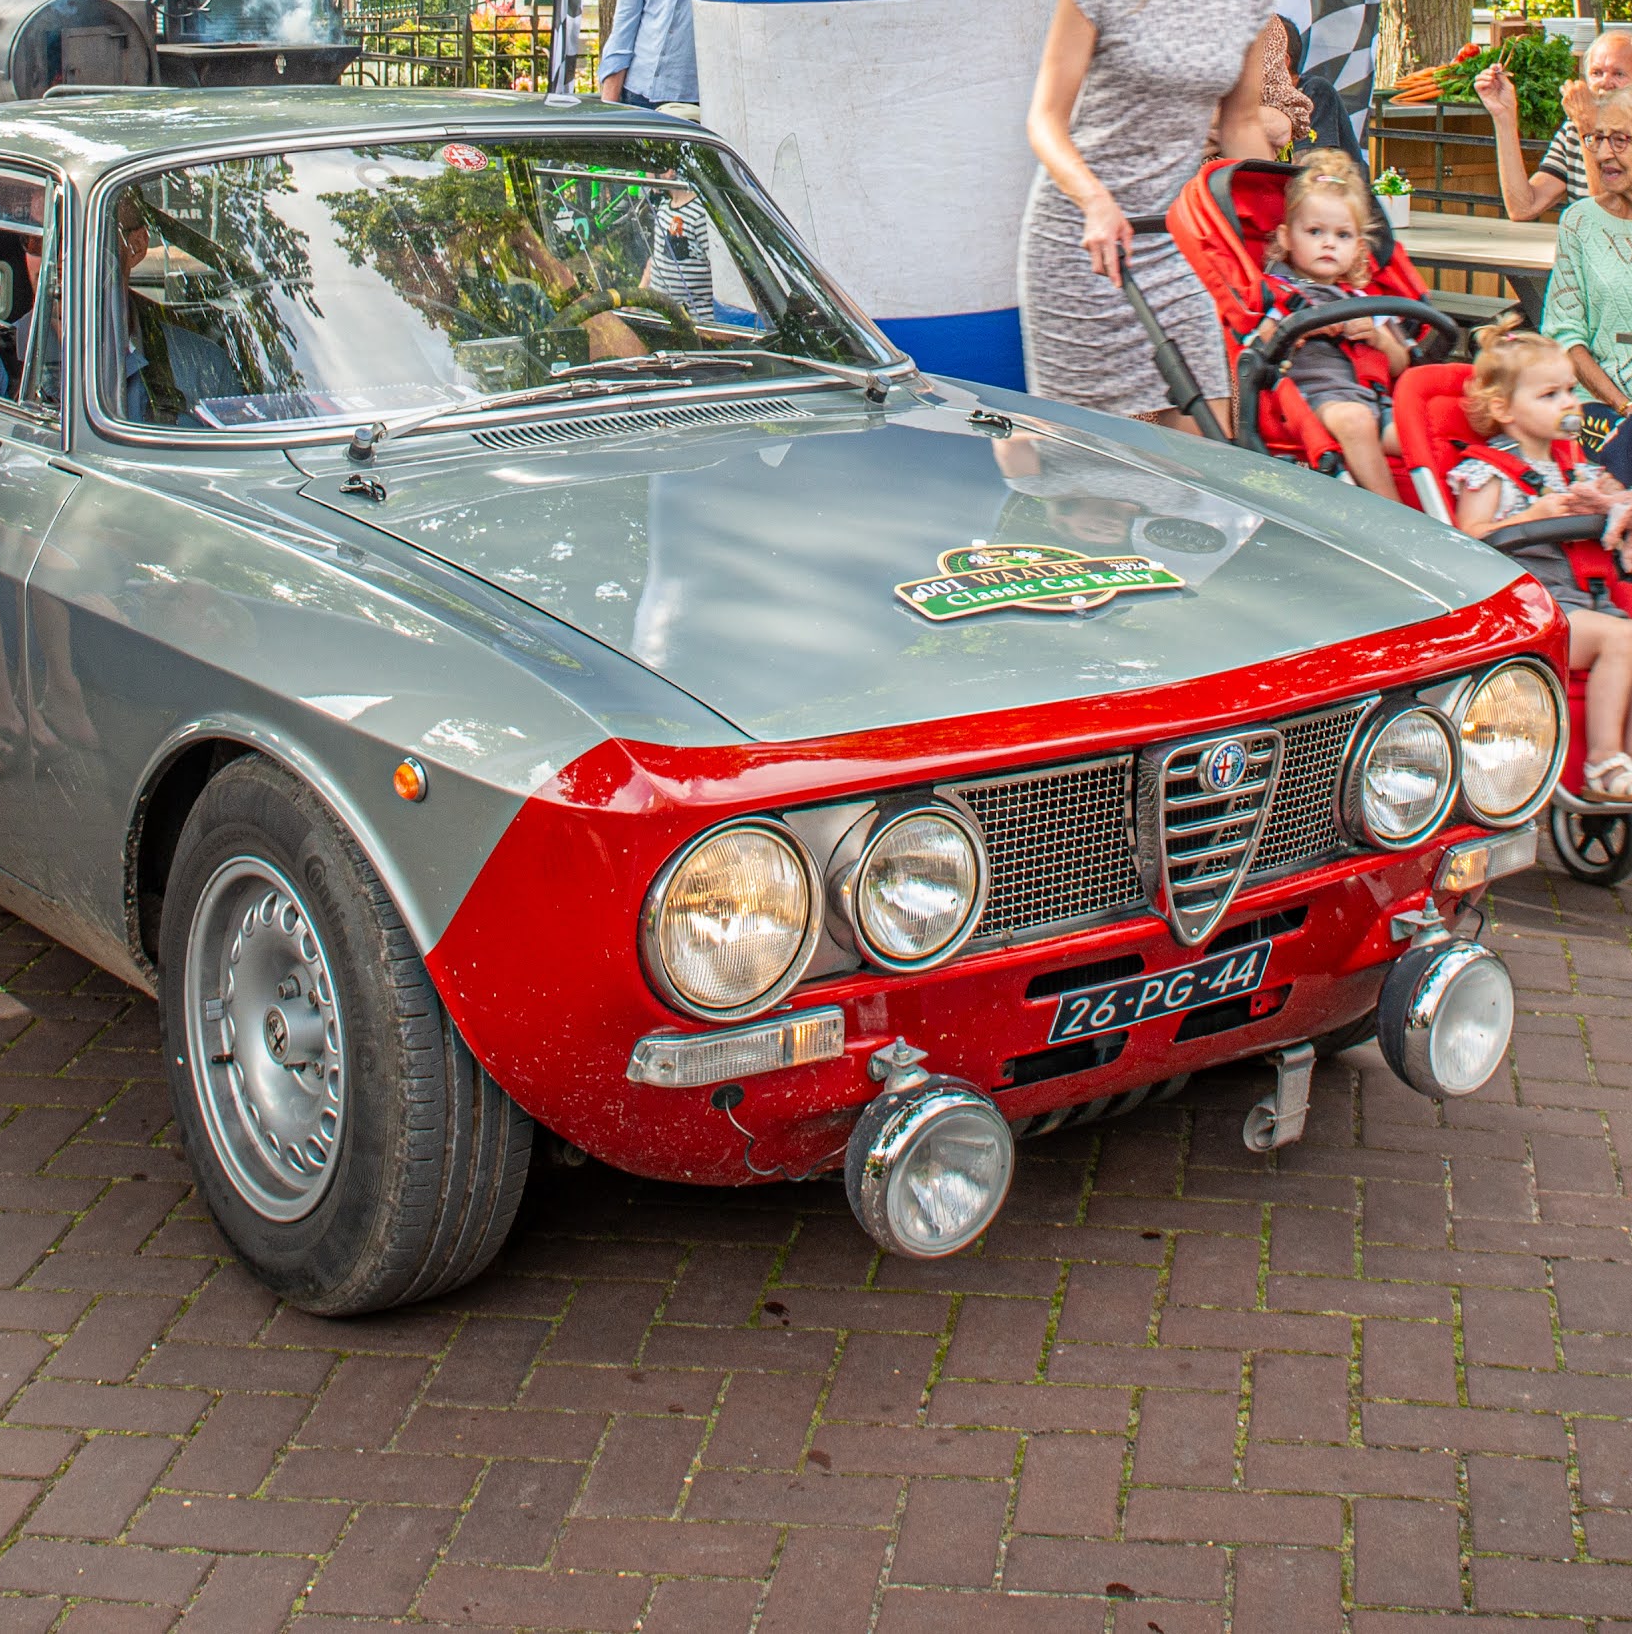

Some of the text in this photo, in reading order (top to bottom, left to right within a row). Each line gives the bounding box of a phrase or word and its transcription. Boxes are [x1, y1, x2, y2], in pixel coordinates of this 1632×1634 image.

[169, 208, 204, 220] BAR
[946, 570, 1155, 606] Classic Car Rally
[969, 562, 1091, 586] WAALRE
[1061, 950, 1258, 1037] 26-PG-44
